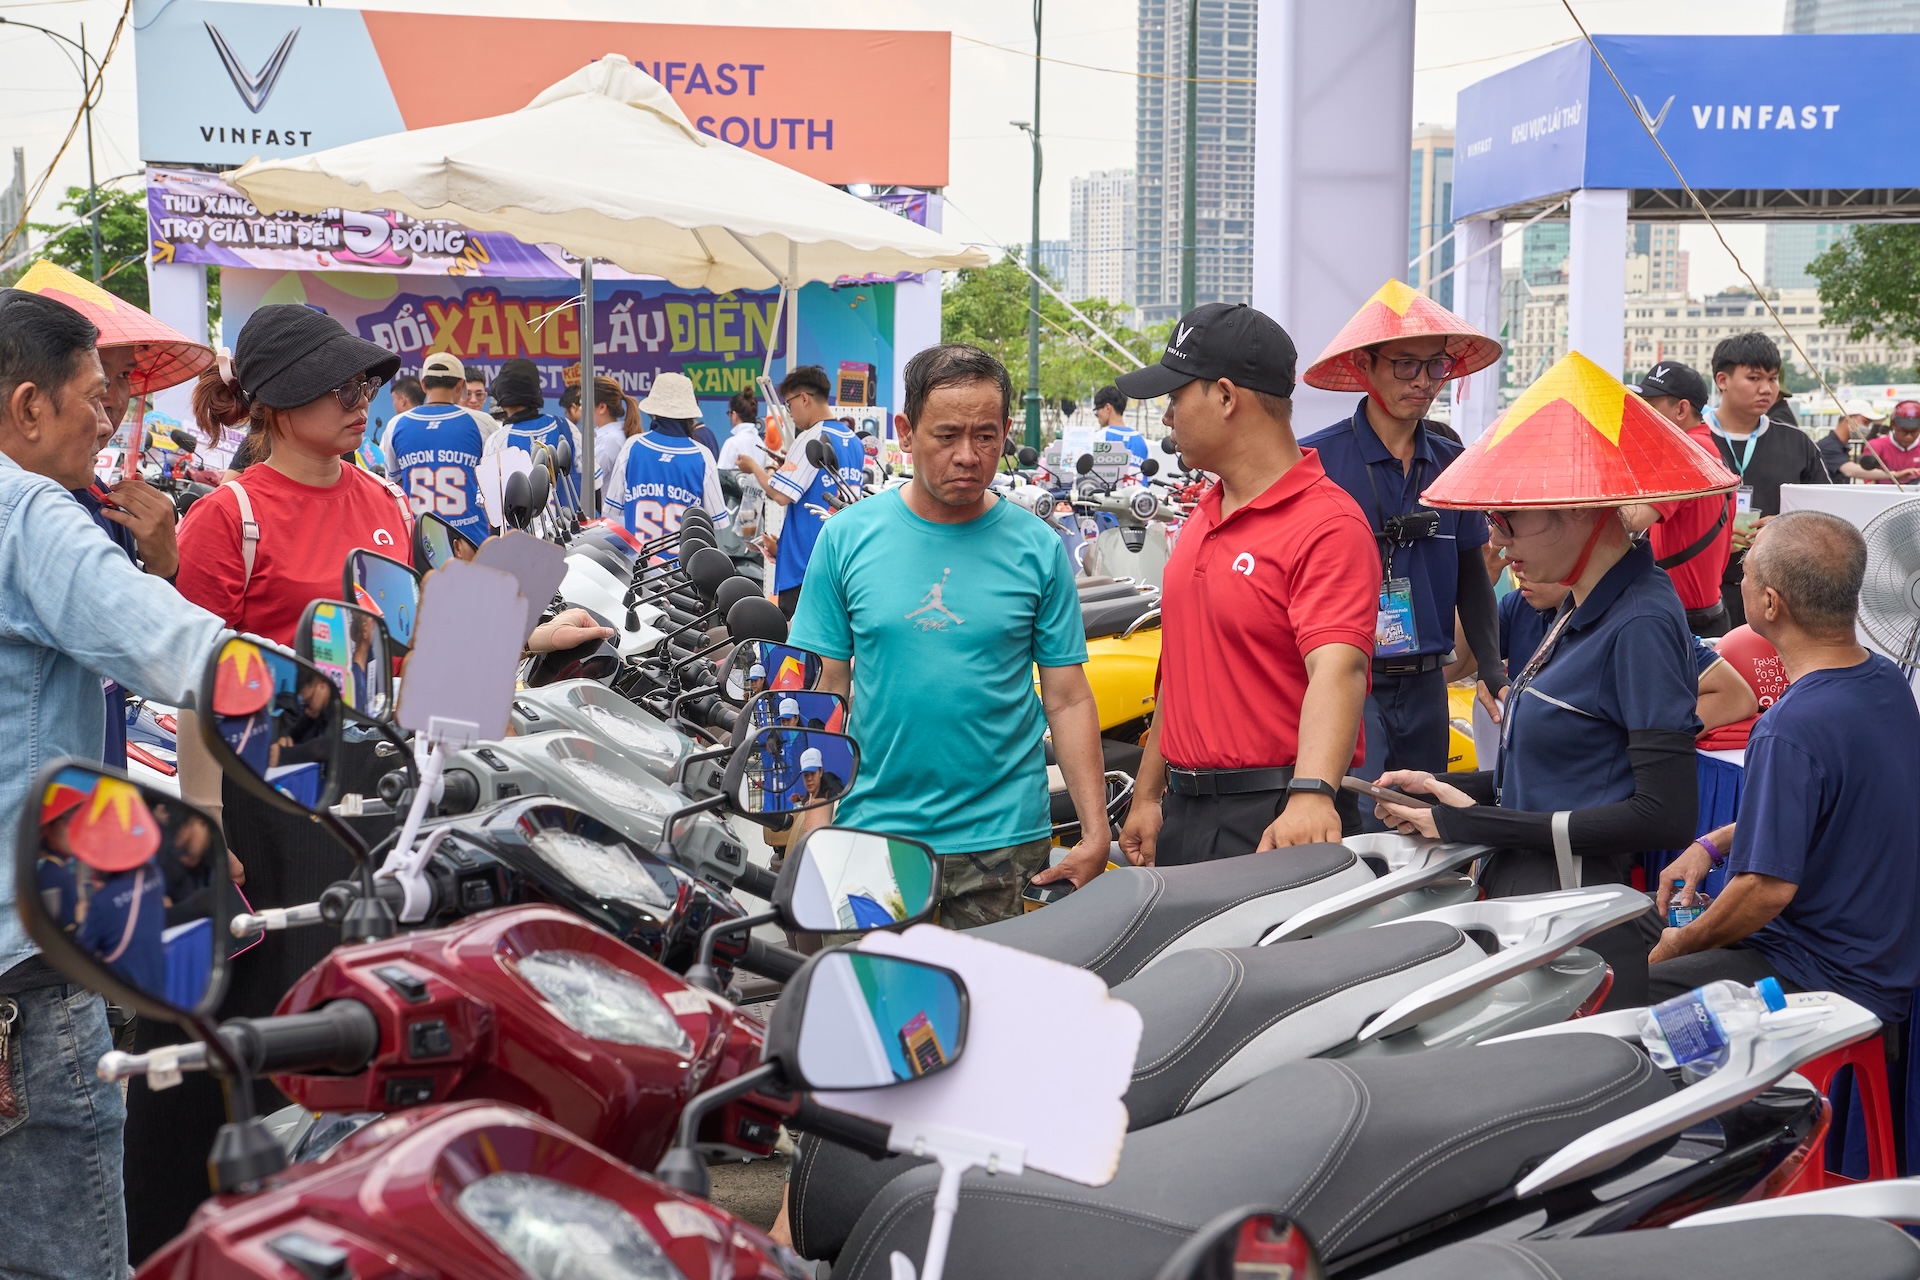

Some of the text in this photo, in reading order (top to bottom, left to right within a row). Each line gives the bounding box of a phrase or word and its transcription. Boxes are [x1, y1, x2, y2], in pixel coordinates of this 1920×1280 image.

[591, 60, 764, 96] FAST
[1512, 99, 1582, 145] KHU VỰC LÁI THỬ
[1692, 104, 1840, 130] VINFAST
[200, 126, 312, 147] VINFAST
[696, 115, 833, 150] SOUTH
[162, 194, 201, 213] THU
[204, 194, 258, 217] XĂNG
[160, 218, 205, 243] TRỢ
[208, 220, 249, 243] GIÁ
[253, 221, 293, 246] LÊN
[297, 218, 340, 247] ĐẾN
[342, 208, 391, 255] 5
[391, 220, 466, 254] ĐỒNG
[424, 295, 580, 357] XĂNG
[687, 367, 756, 393] XANH
[398, 450, 435, 470] SAIGON
[437, 449, 479, 468] SOUTH
[409, 466, 467, 516] SS
[625, 483, 664, 502] SAIGON
[449, 515, 480, 527] SUPERIOR
[1752, 656, 1779, 668] TRUST
